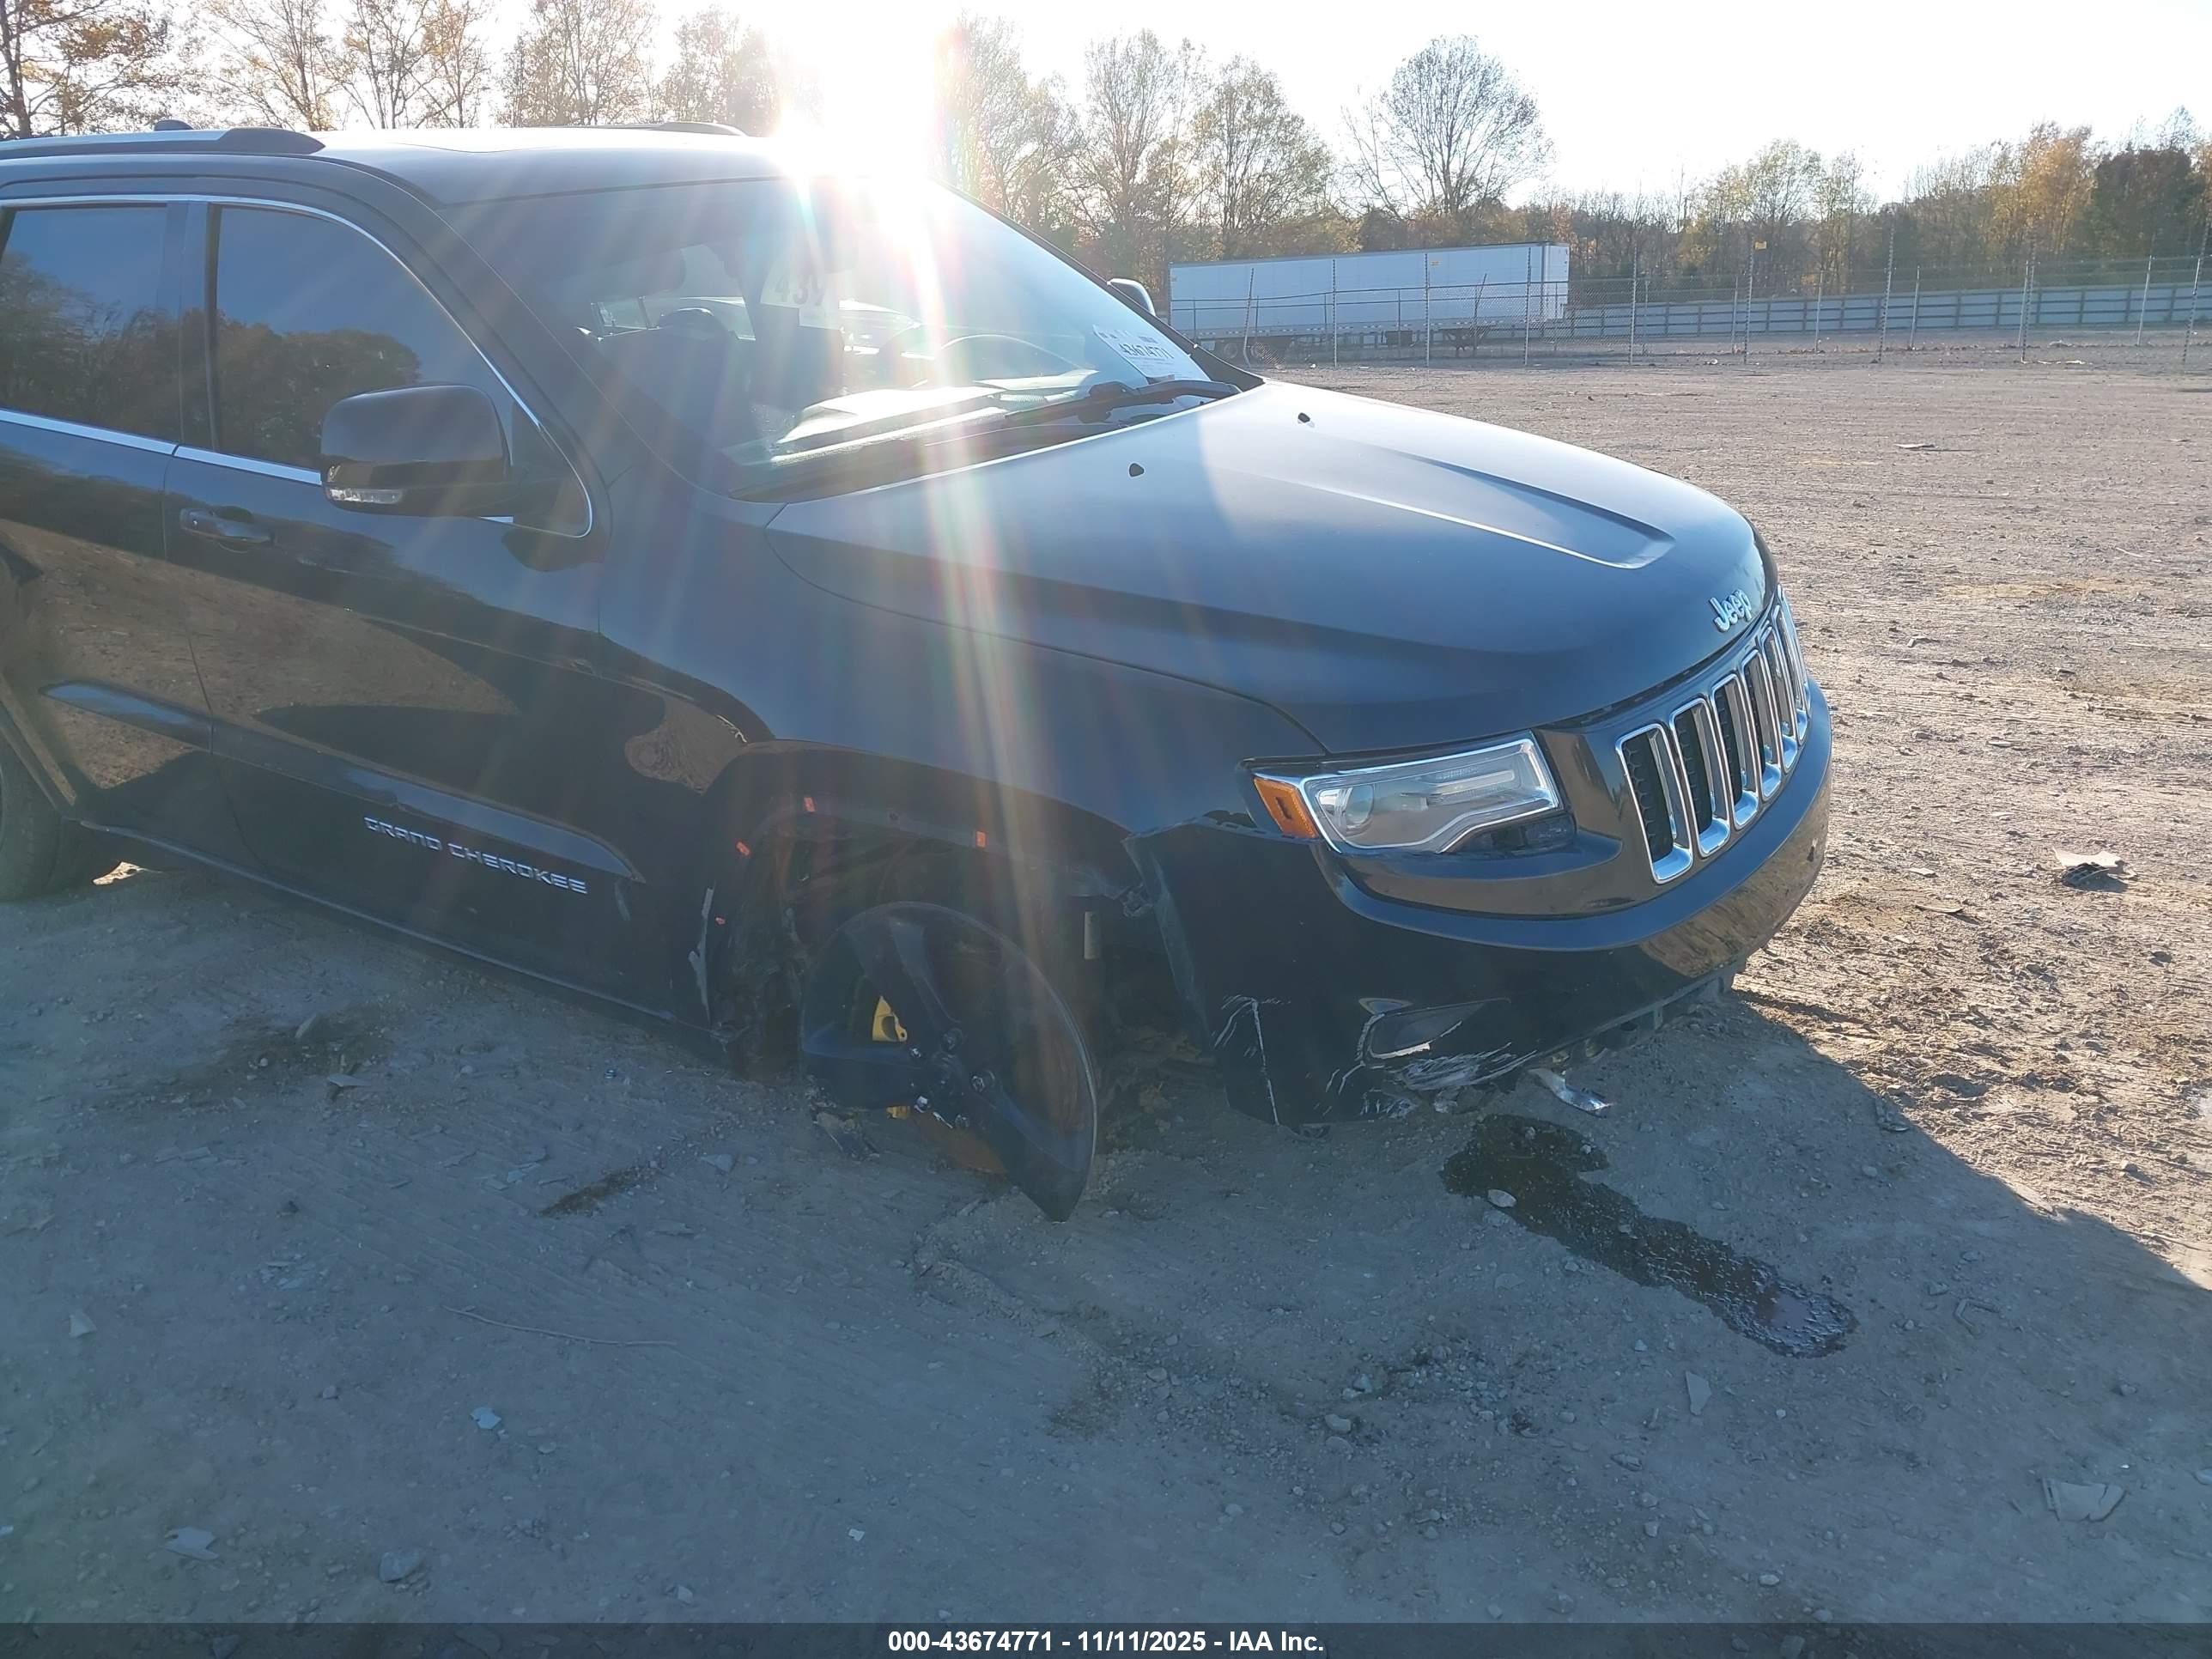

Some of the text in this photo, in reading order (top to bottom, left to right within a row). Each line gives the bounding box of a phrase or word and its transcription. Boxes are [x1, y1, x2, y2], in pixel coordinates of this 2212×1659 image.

[1710, 589, 1752, 631] Jeep
[364, 817, 587, 894] GRAND CHEROKEE
